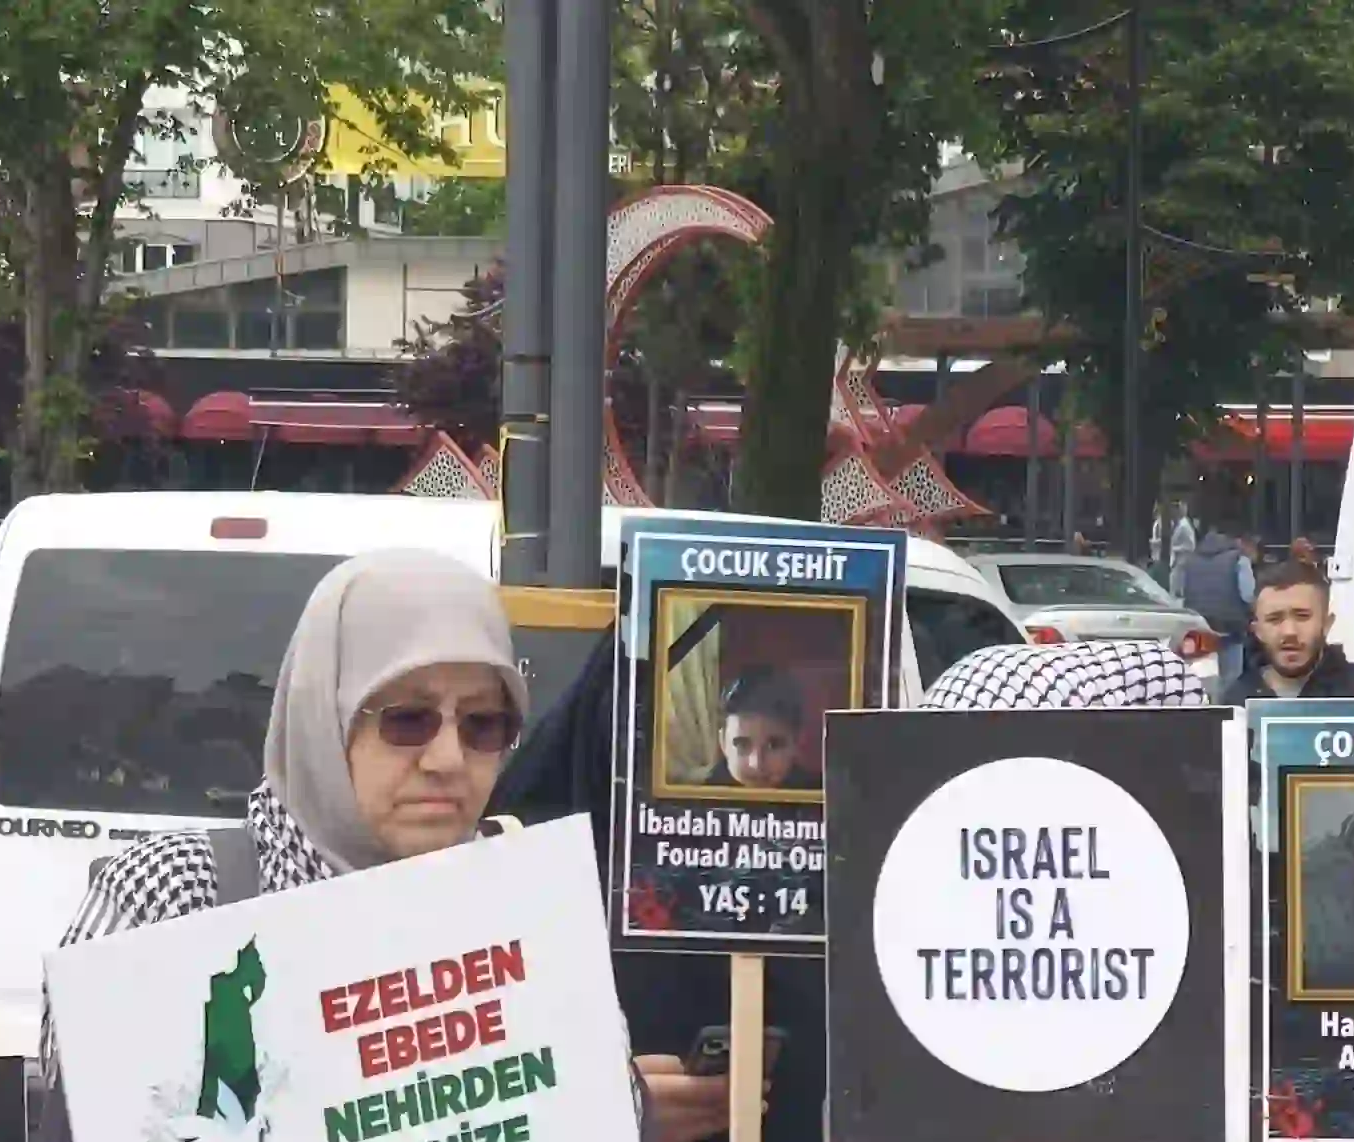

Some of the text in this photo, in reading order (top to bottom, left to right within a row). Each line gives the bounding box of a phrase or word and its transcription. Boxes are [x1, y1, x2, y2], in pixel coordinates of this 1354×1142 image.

[681, 547, 848, 586] ÇOCUK ŞEHİT
[639, 803, 721, 838] İbadah
[657, 841, 730, 868] Fouad
[789, 846, 824, 871] Ou
[960, 827, 1110, 880] ISRAEL
[699, 885, 750, 921] YAŞ
[775, 887, 808, 915] 14
[996, 887, 1075, 940] IS A
[320, 939, 526, 1033] EZELDEN
[916, 947, 1155, 1001] TERRORIST
[358, 999, 506, 1078] EBEDE
